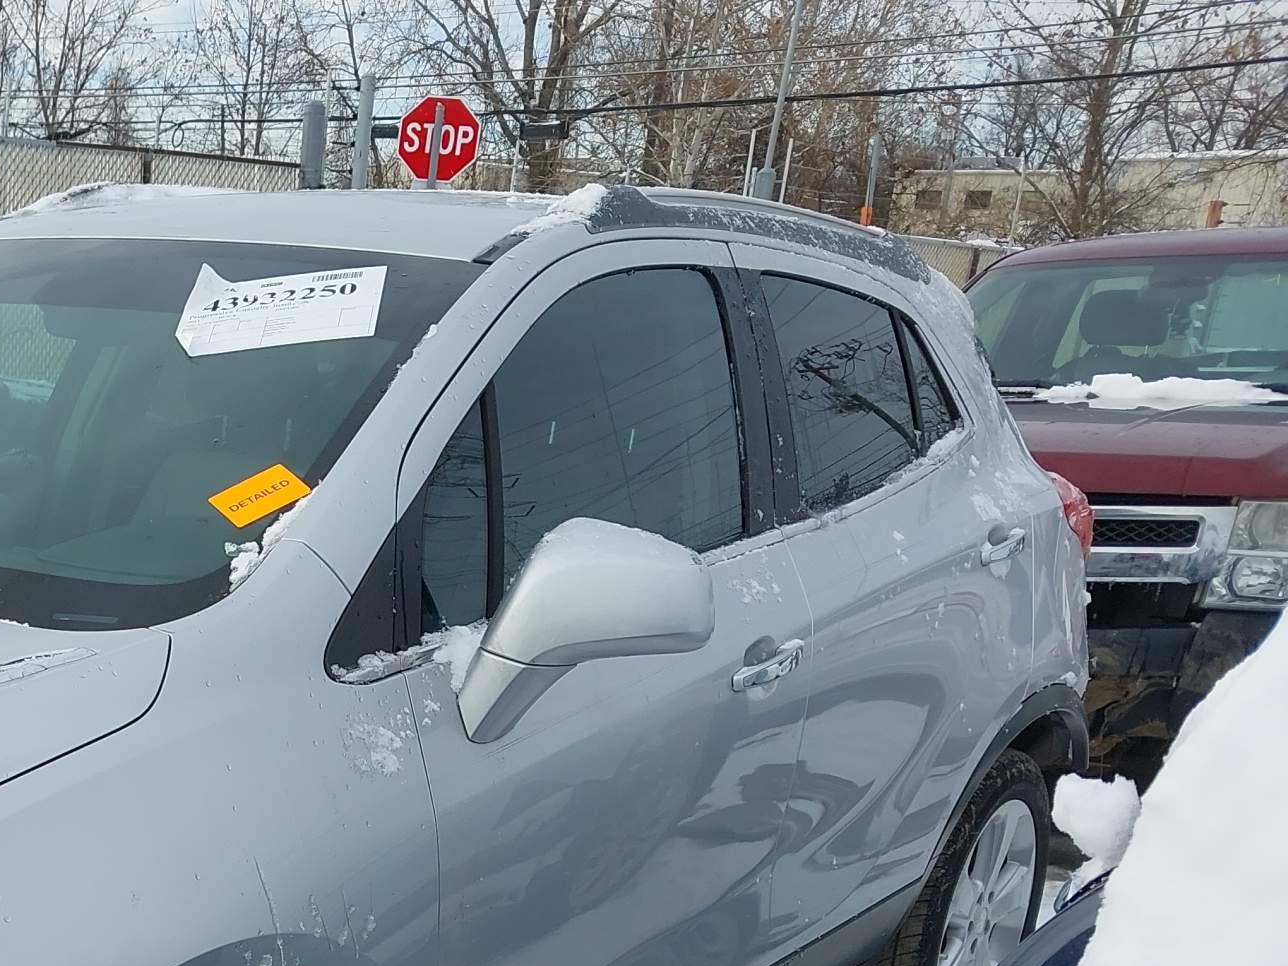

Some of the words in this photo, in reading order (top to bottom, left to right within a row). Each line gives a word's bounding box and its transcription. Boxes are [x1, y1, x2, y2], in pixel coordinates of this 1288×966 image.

[404, 123, 474, 156] STOP
[203, 283, 357, 312] 43932250
[228, 480, 290, 512] DETAILED
